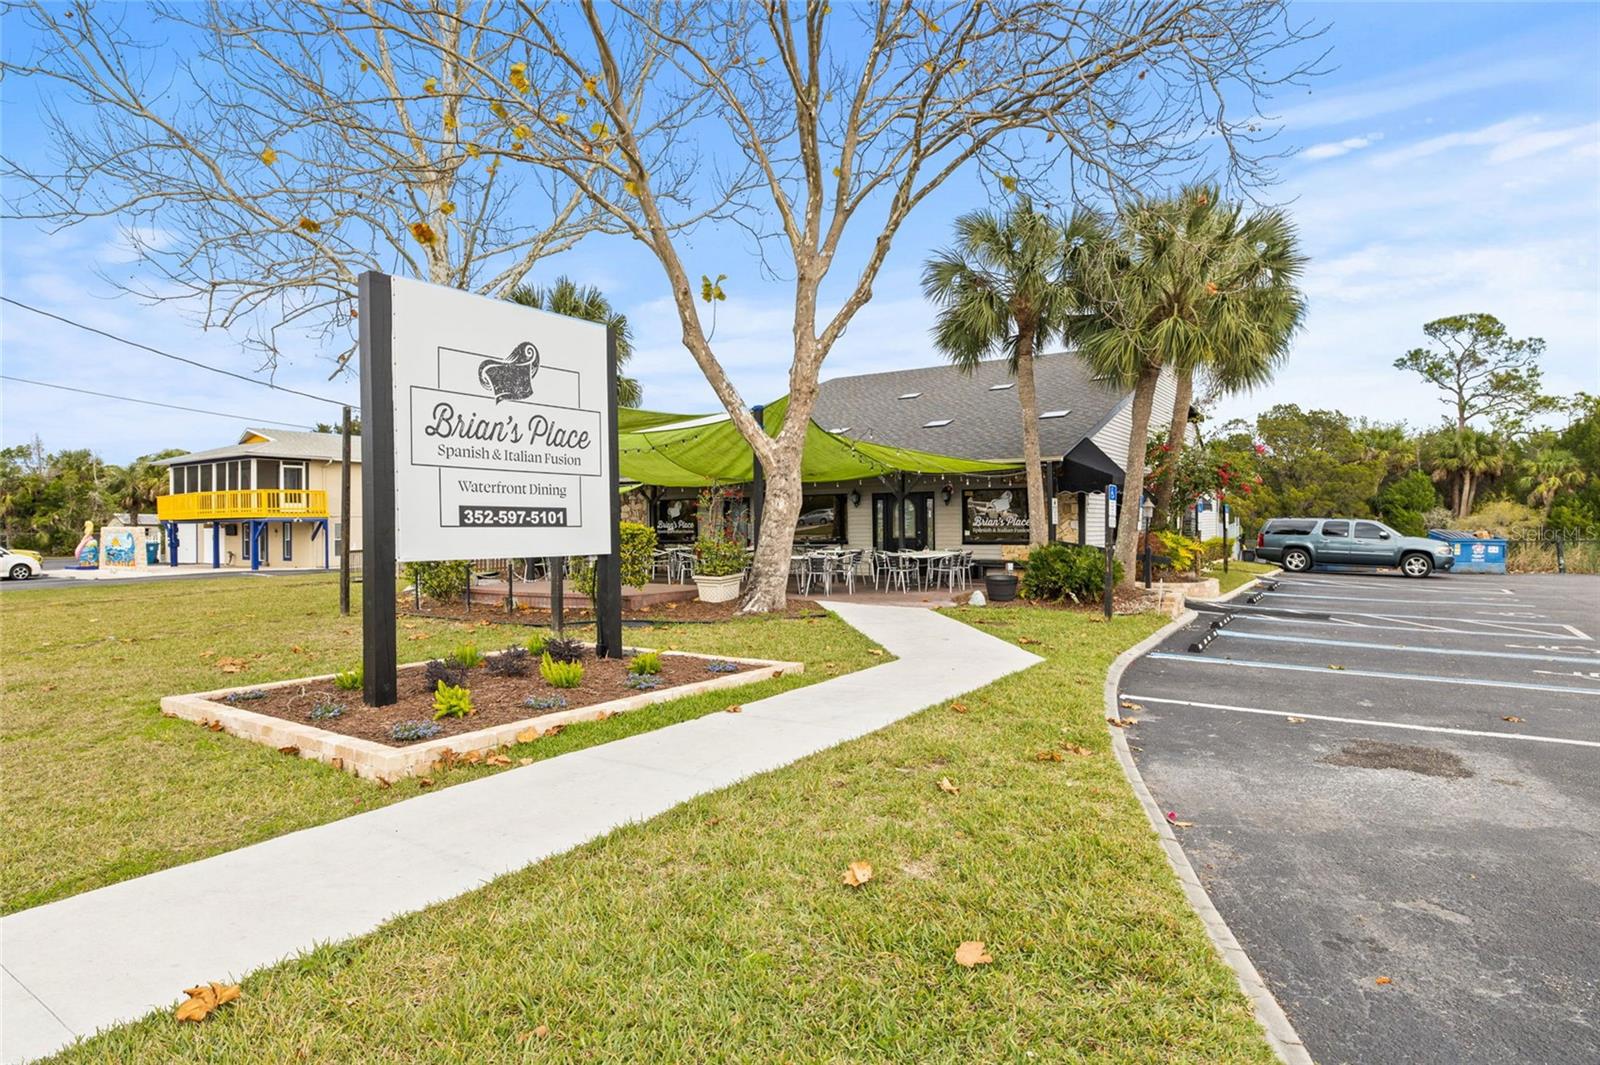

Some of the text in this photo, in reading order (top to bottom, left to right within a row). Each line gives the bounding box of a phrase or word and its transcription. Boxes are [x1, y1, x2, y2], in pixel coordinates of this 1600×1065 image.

[425, 402, 591, 450] Brian's Place
[437, 443, 581, 466] Spanish & Italian Fusion
[458, 480, 567, 498] Waterfront Dining
[463, 509, 564, 524] 352-597-5101
[972, 515, 1005, 527] Brian's
